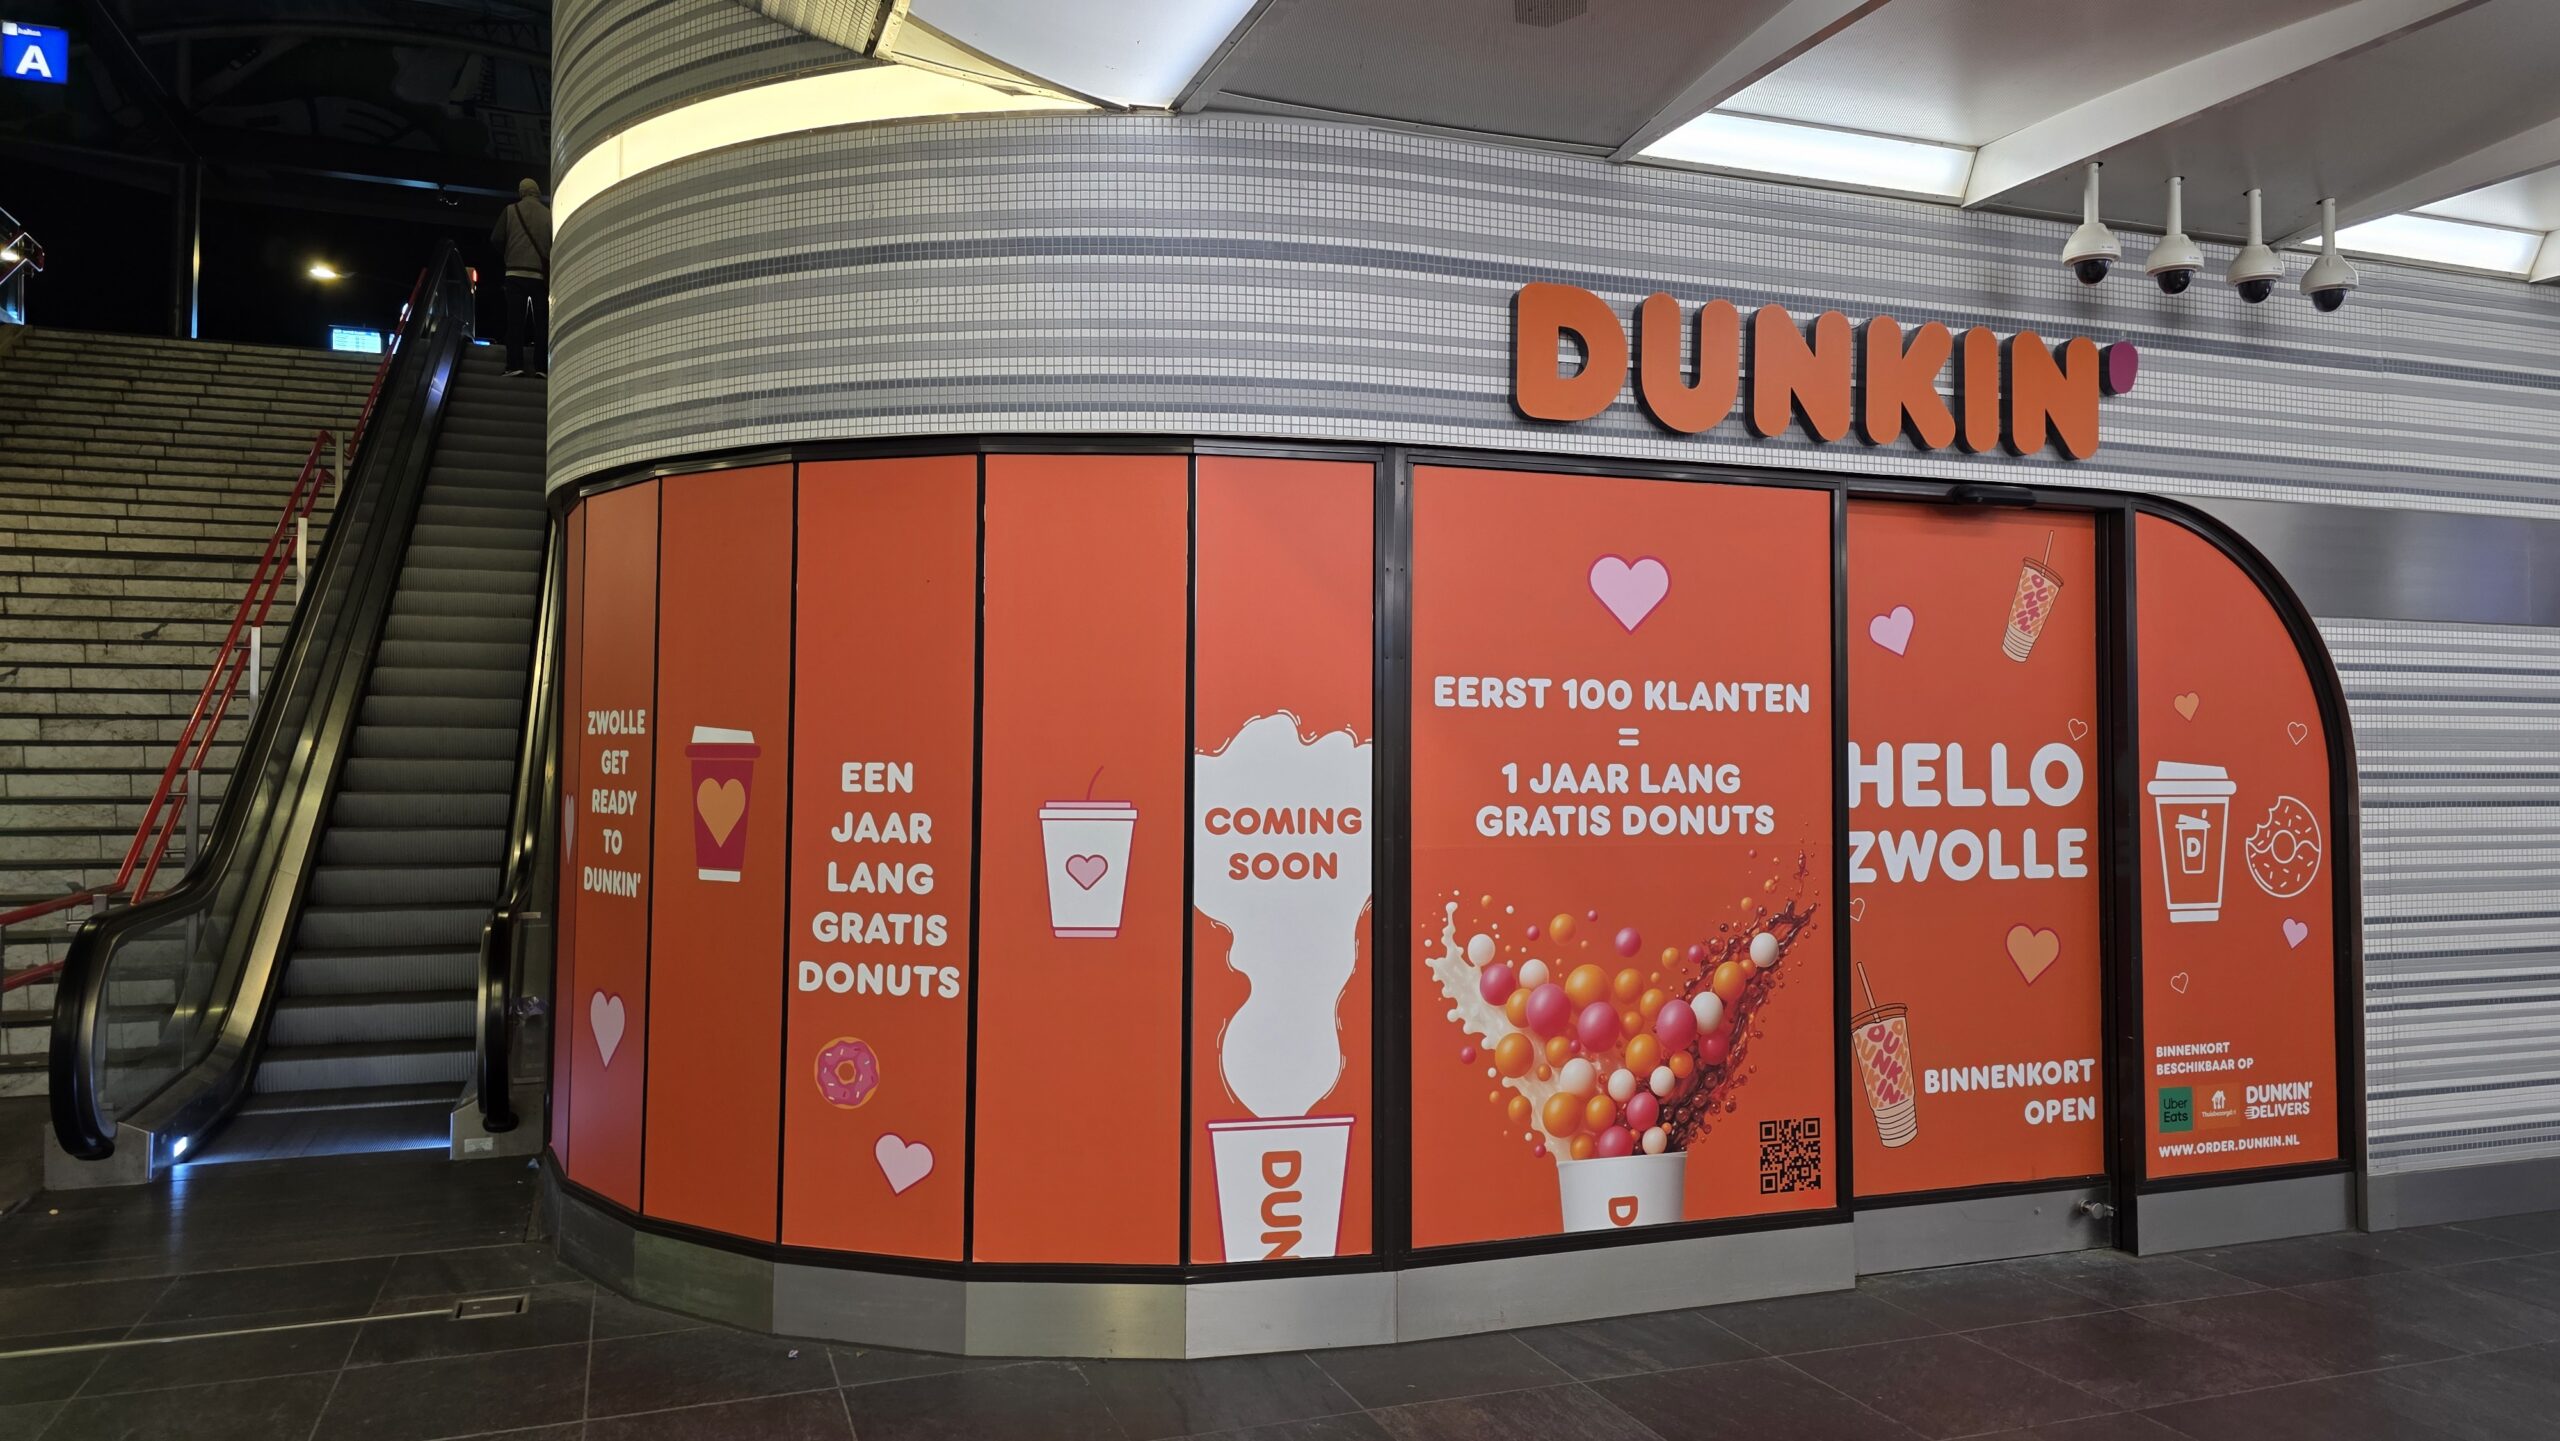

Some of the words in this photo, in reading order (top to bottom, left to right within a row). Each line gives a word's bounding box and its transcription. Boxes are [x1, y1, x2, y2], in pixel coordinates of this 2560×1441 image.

[15, 44, 52, 78] A
[1512, 281, 2138, 460] DUNKIN'
[1434, 676, 1552, 709] EERST
[1562, 678, 1633, 710] 100
[1644, 680, 1810, 713] KLANTEN
[587, 709, 646, 735] ZWOLLE
[601, 749, 629, 775] GET
[841, 761, 913, 793] EEN
[1848, 741, 2084, 809] HELLO
[1502, 763, 1518, 794] 1
[1529, 763, 1629, 794] JAAR
[1641, 763, 1741, 794] LANG
[591, 788, 637, 816] READY
[831, 811, 932, 844] JAAR
[1205, 807, 1362, 836] COMING
[1475, 805, 1611, 837] GRATIS
[1622, 804, 1775, 836] DONUTS
[602, 828, 623, 855] TO
[1849, 828, 2088, 883] ZWOLLE
[827, 861, 934, 895] LANG
[1228, 852, 1338, 880] SOON
[583, 866, 641, 898] DUNKIN'
[812, 911, 948, 947] GRATIS
[798, 960, 960, 999] DONUTS
[2156, 1042, 2231, 1058] BINNENKORT
[1924, 1058, 2096, 1094] BINNENKORT
[2156, 1059, 2235, 1076] BESCHIKBAAR
[2238, 1057, 2254, 1070] OP
[2163, 1097, 2188, 1110] Uber
[2246, 1081, 2313, 1104] DUNKIN'
[2024, 1096, 2096, 1125] OPEN
[2163, 1111, 2189, 1123] Eats
[2244, 1101, 2310, 1120] DELIVERS
[2158, 1134, 2300, 1158] WWW.ORDER.DUNKIN.NL
